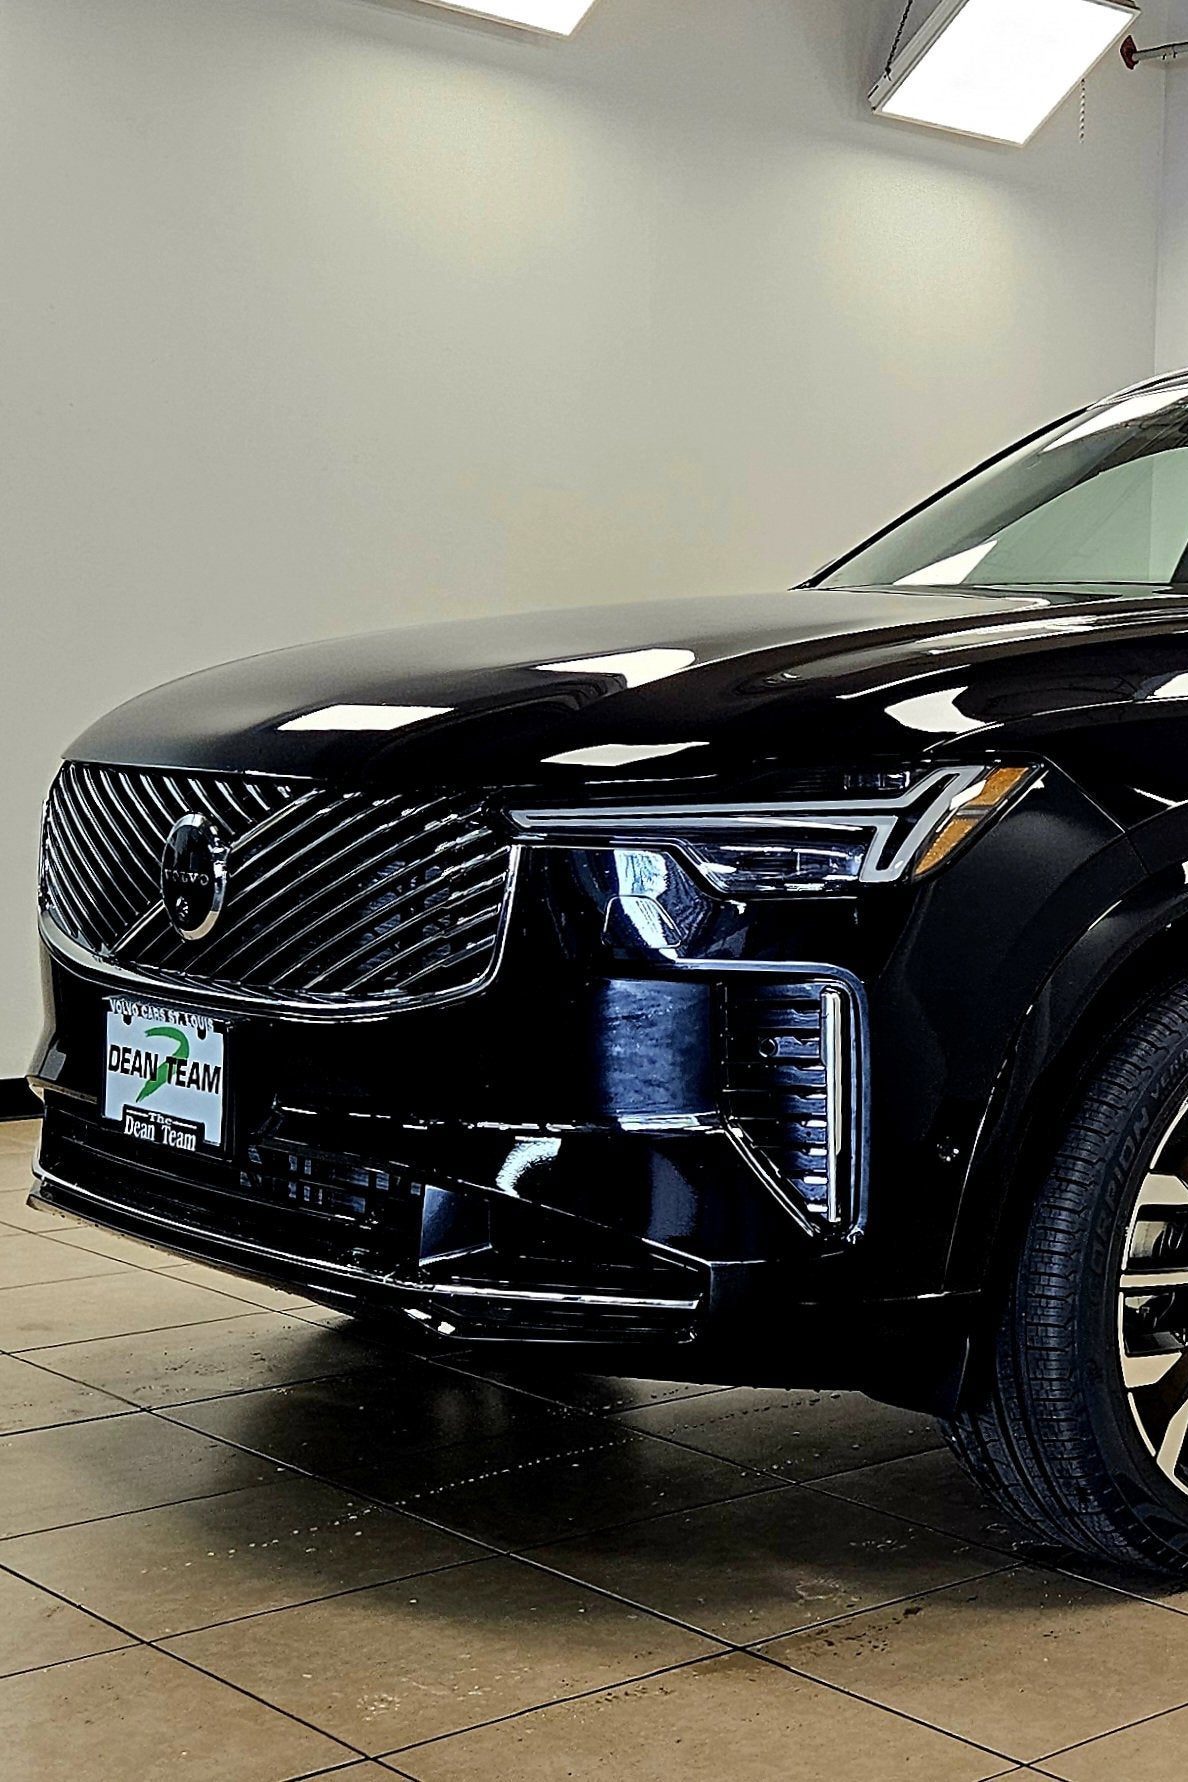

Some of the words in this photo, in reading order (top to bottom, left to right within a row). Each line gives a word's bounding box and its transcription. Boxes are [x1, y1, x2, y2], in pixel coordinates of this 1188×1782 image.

[164, 868, 210, 887] VOLVO
[109, 999, 138, 1016] VOLVO
[141, 1003, 166, 1023] CARS
[108, 1044, 159, 1082] DEAN
[165, 1056, 222, 1095] TEAM
[148, 1112, 173, 1126] The
[123, 1114, 155, 1141] Dean
[162, 1124, 197, 1152] Team
